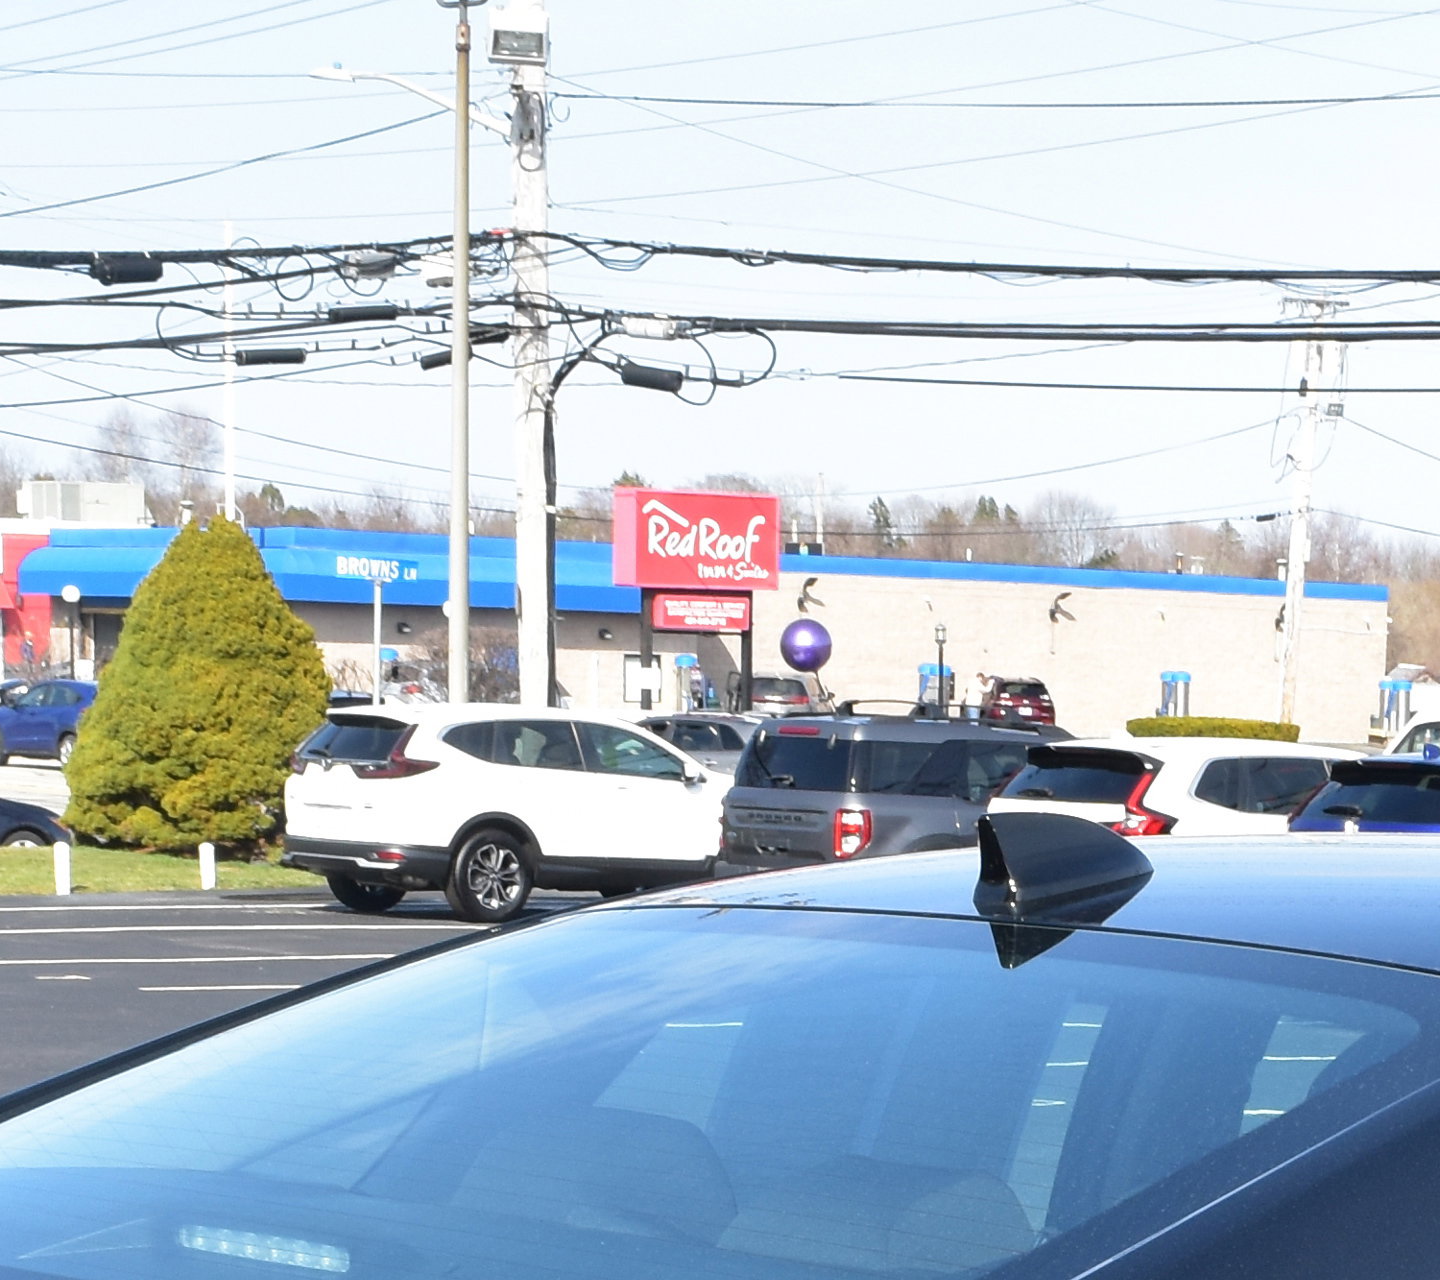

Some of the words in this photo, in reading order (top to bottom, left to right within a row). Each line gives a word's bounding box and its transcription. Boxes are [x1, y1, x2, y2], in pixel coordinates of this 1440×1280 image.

[647, 514, 698, 558] Red
[698, 514, 767, 564] Roof
[336, 555, 400, 579] BROWNS
[697, 562, 727, 579] Inn
